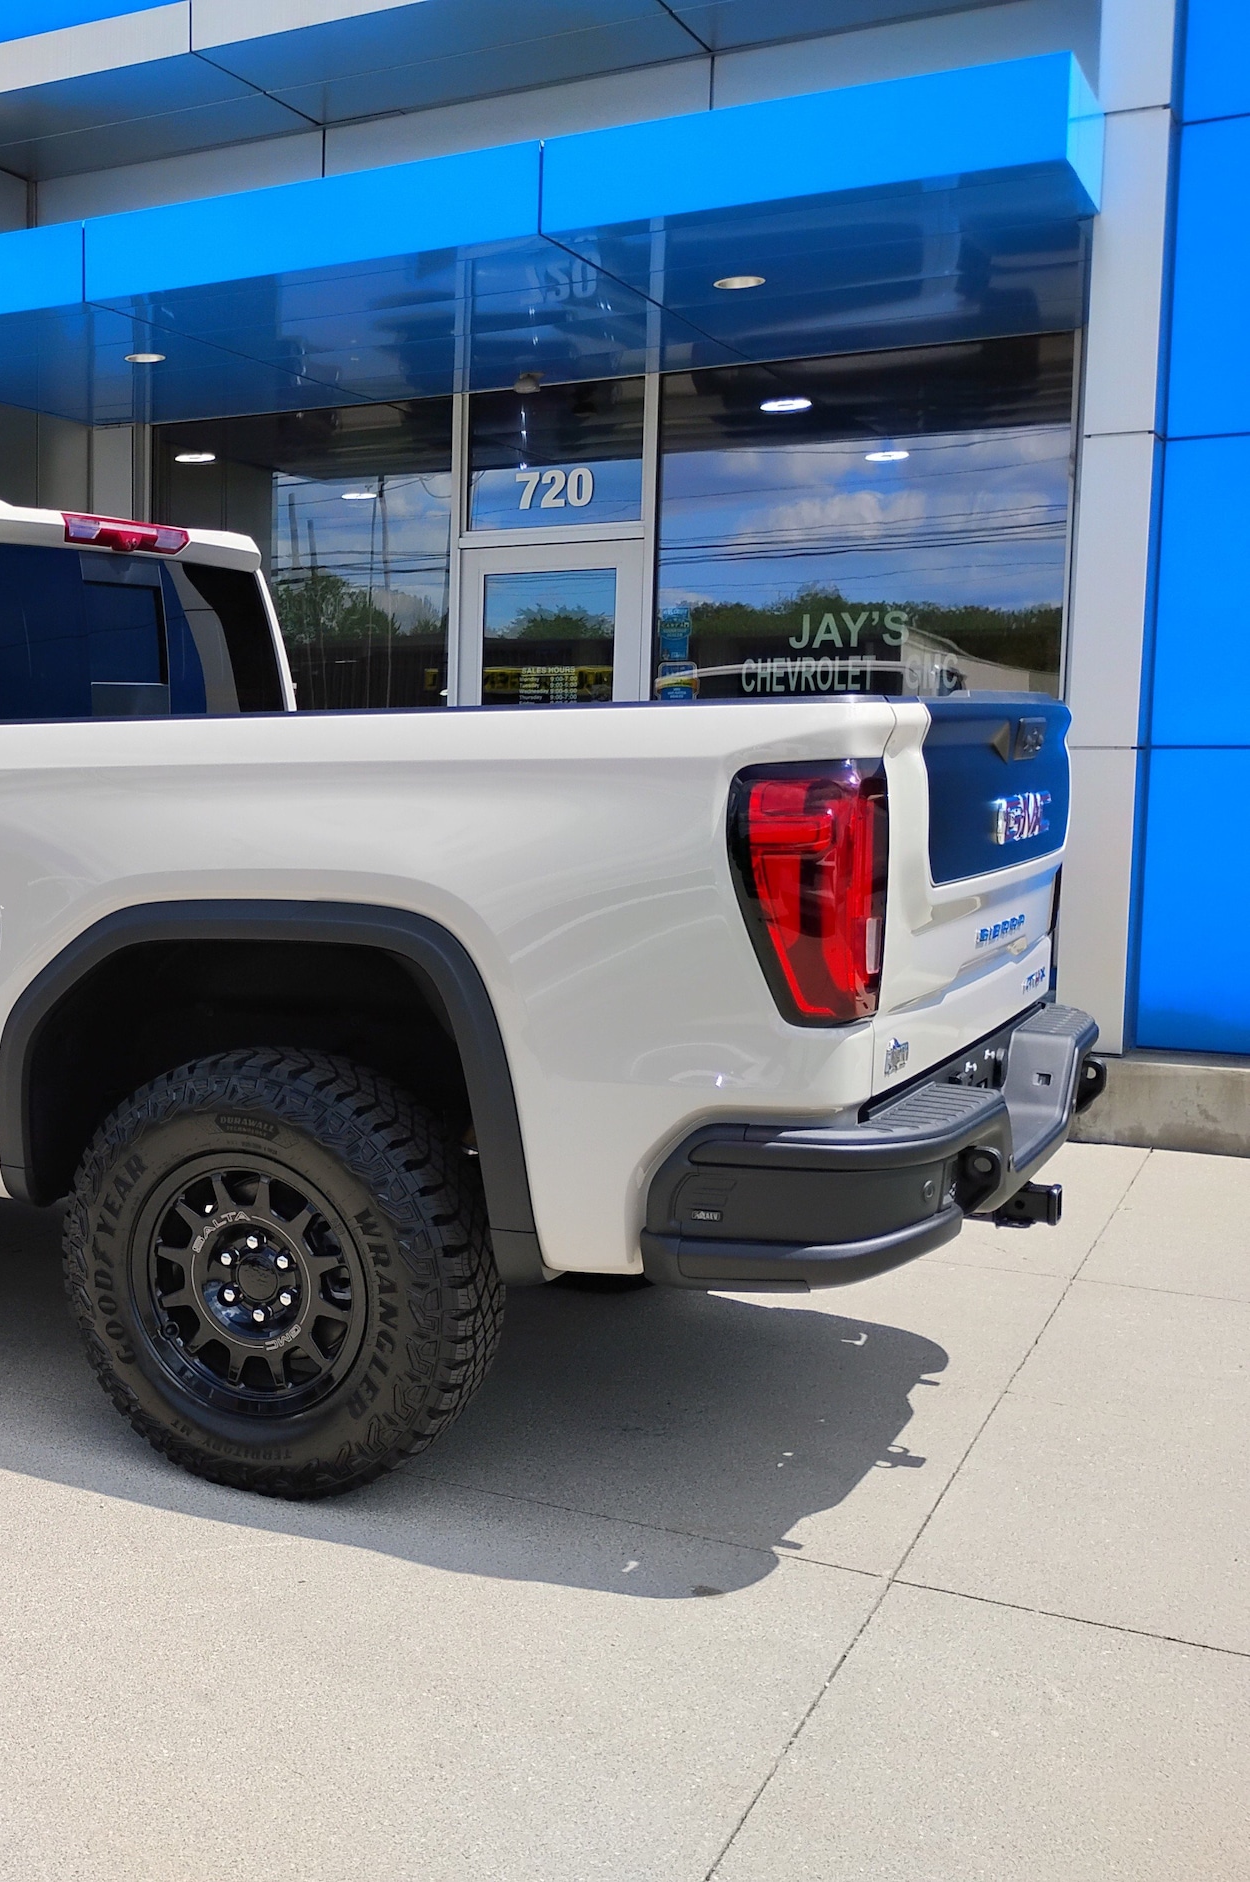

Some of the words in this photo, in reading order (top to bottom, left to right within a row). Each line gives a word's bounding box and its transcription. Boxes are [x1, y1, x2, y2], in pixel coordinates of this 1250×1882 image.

[515, 467, 594, 510] 720
[788, 610, 910, 650] JAY'S
[521, 666, 547, 674] SALES
[548, 666, 576, 674] HOURS
[741, 654, 877, 693] CHEVROLET
[905, 652, 959, 690] GMC
[974, 913, 1025, 947] SIERRA
[219, 1115, 276, 1133] DURAWALL
[92, 1153, 149, 1365] GOODYEAR
[350, 1207, 399, 1421] WRANGLER
